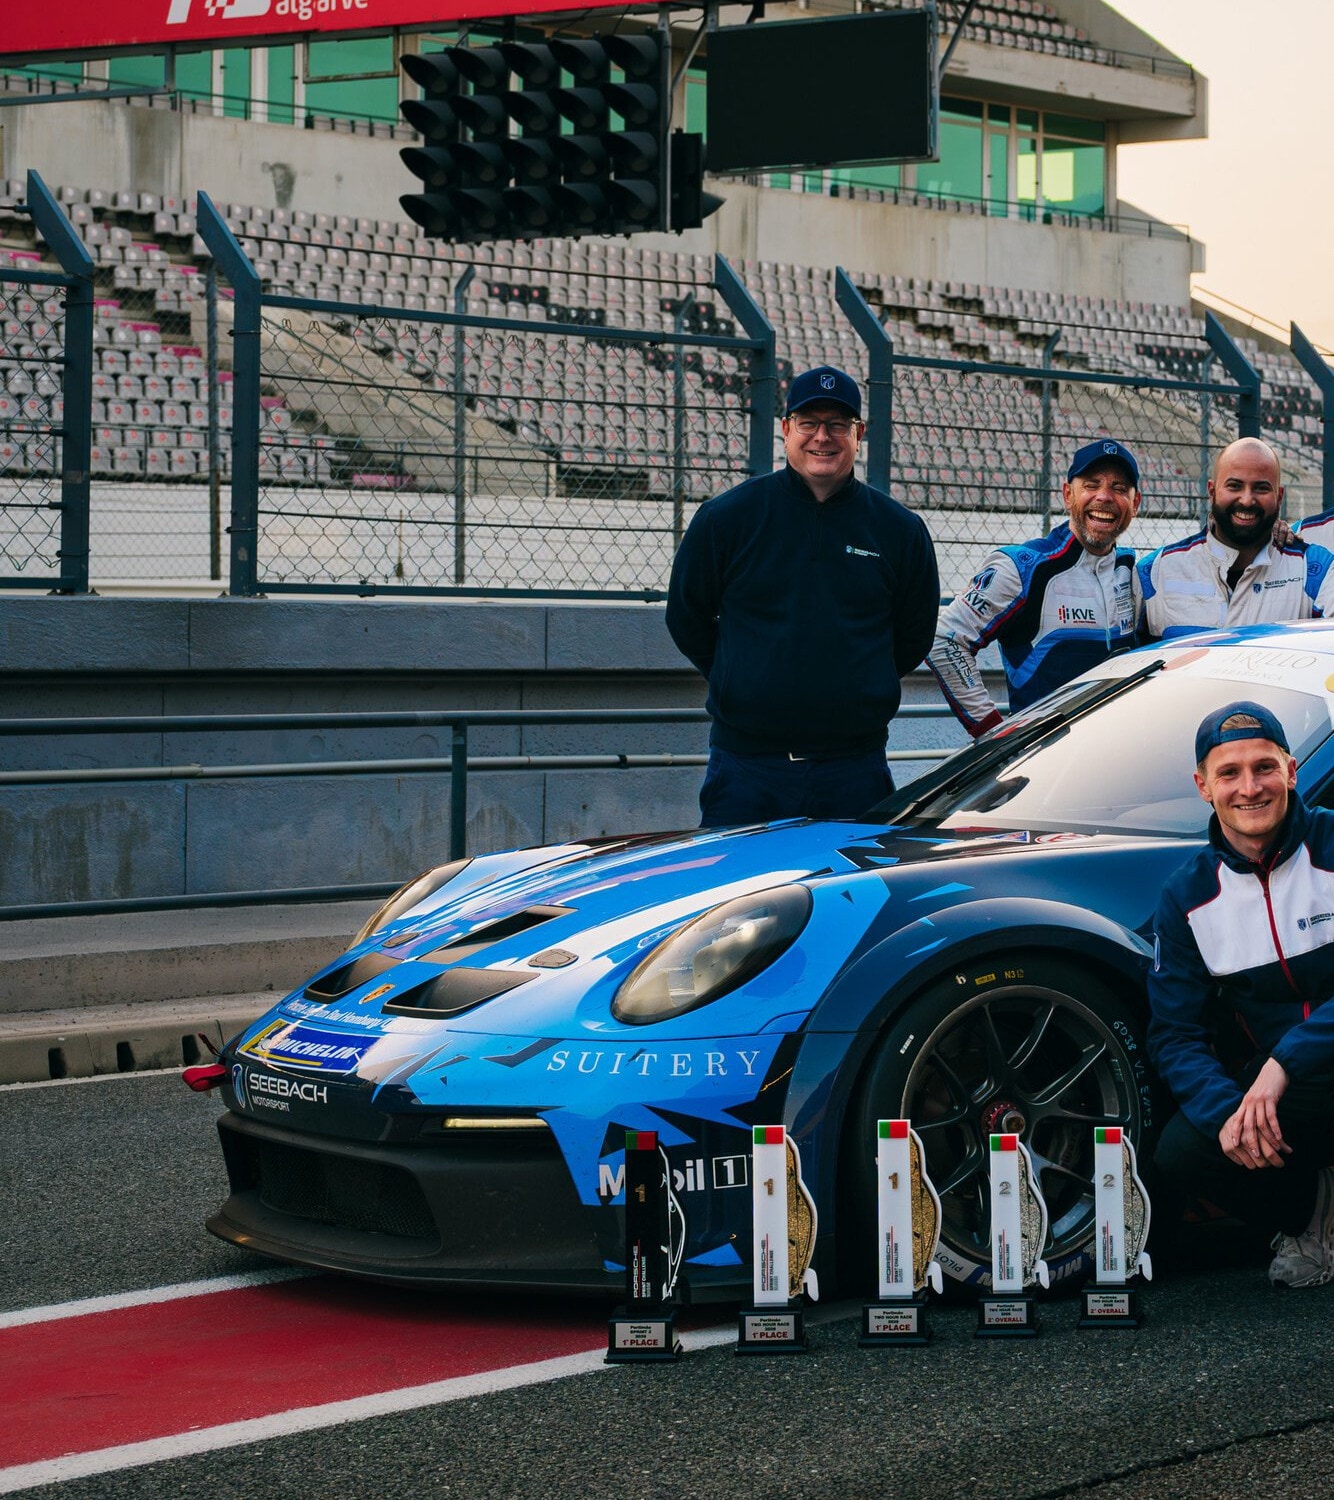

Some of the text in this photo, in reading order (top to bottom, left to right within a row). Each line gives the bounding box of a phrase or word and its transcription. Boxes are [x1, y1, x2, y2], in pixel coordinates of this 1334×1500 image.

[275, 0, 368, 20] algarve
[965, 591, 991, 616] KVE
[1072, 608, 1095, 620] KVE
[275, 1038, 361, 1060] MICHELIN
[546, 1050, 760, 1077] SUITERY
[250, 1073, 328, 1103] SEEBACH
[252, 1094, 290, 1112] MOTORSPORT
[599, 1159, 705, 1197] Mil
[763, 1178, 774, 1195] 1
[888, 1172, 898, 1189] 1
[1102, 1174, 1115, 1188] 2
[634, 1183, 646, 1202] 1
[999, 1181, 1012, 1195] 2
[935, 1251, 964, 1273] PILOT
